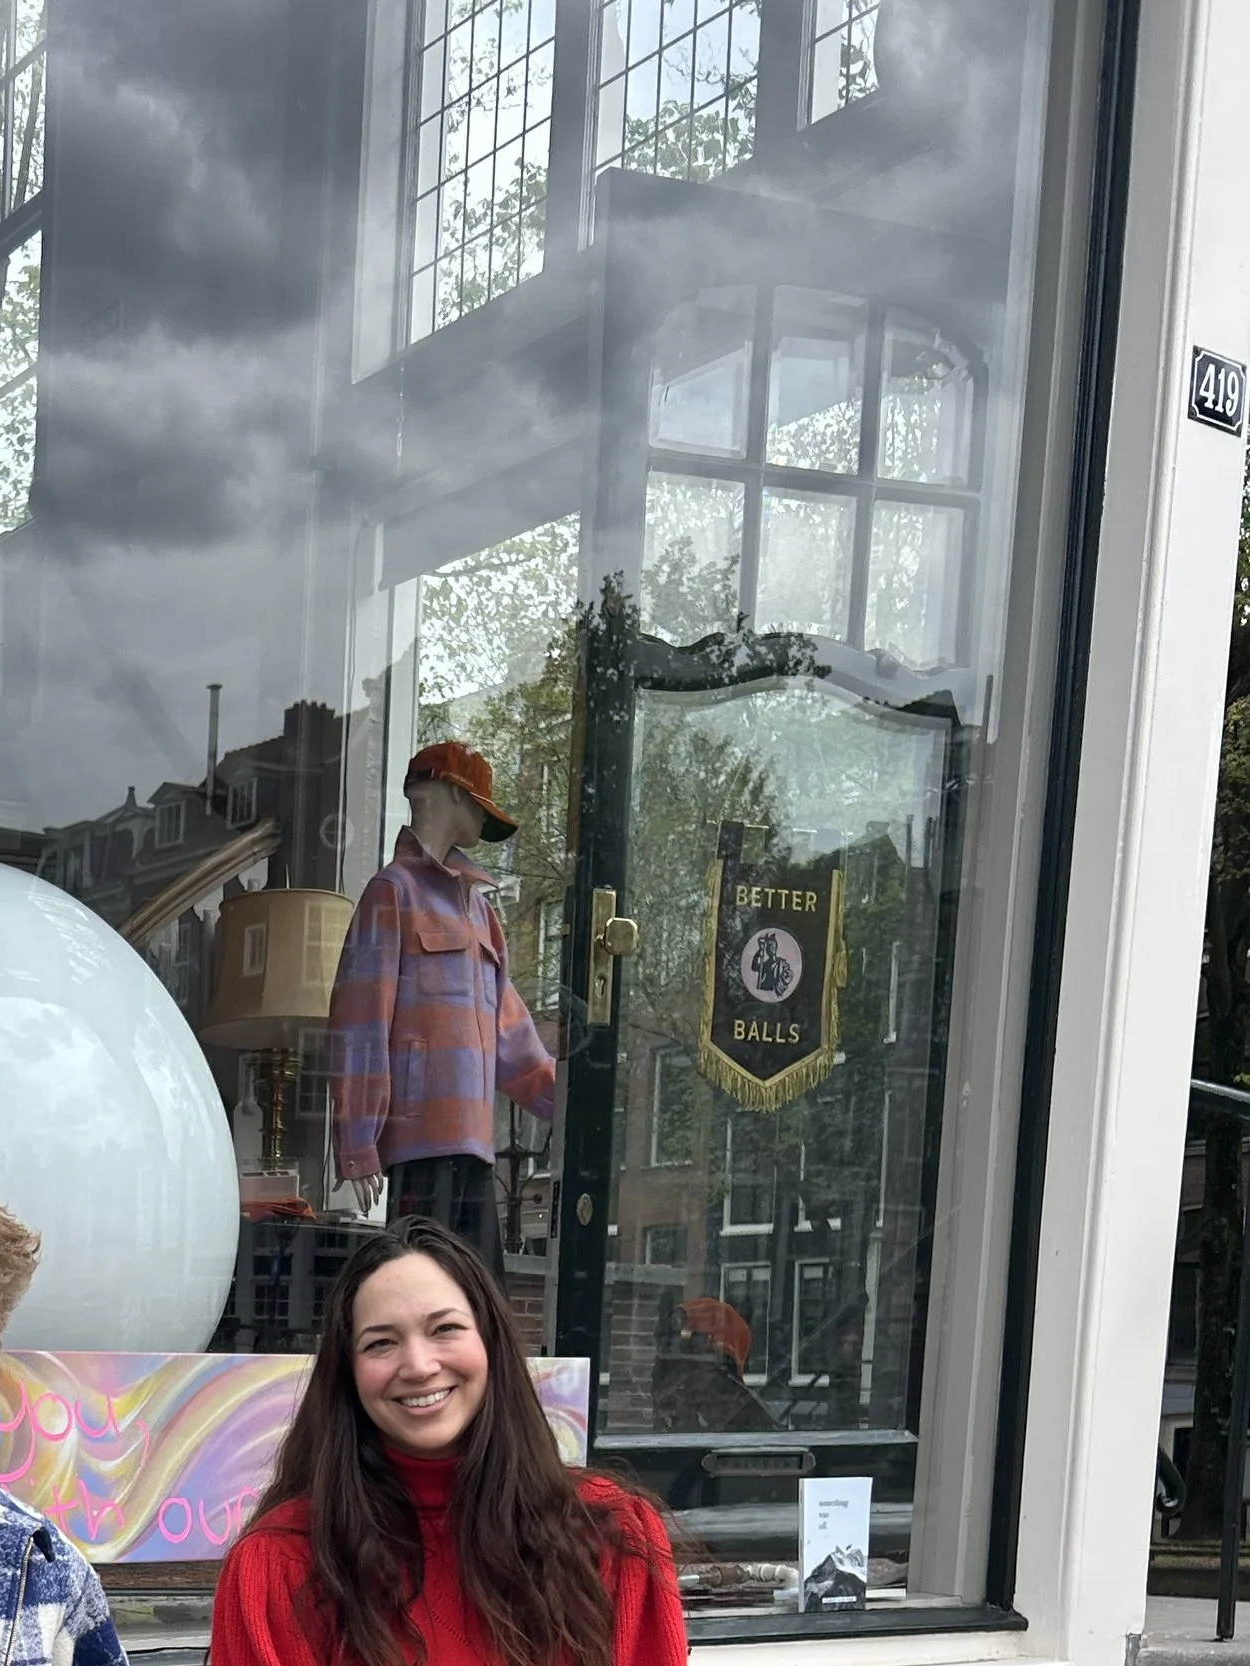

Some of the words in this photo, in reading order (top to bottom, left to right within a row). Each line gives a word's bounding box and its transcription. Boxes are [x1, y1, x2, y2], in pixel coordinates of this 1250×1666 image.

[1199, 363, 1239, 417] 419
[736, 885, 817, 912] BETTER
[733, 1019, 800, 1044] BALLS
